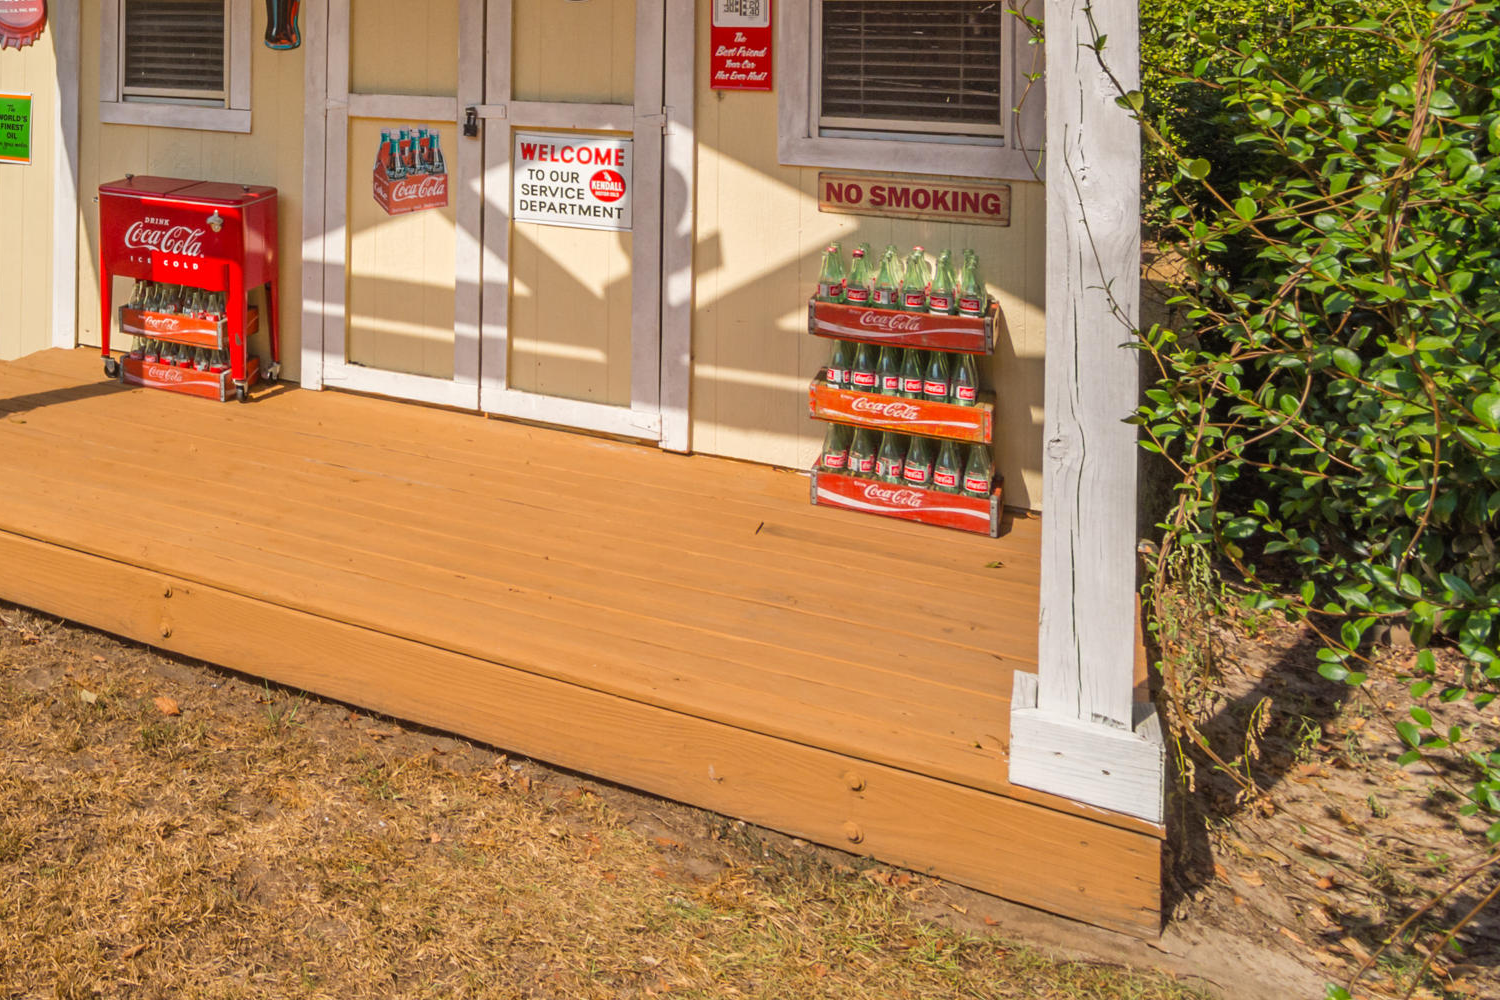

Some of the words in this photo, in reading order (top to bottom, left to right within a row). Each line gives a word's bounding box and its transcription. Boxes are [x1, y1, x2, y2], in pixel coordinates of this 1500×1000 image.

[714, 45, 737, 56] Best
[736, 46, 767, 57] Friend
[0, 122, 24, 131] FINEST
[6, 131, 18, 139] OIL
[520, 142, 625, 167] WELCOME
[527, 168, 545, 181] TO
[549, 170, 580, 184] OUR
[392, 176, 445, 202] Coca-Cola
[521, 183, 585, 200] SERVICE
[590, 180, 623, 192] KENDALL
[825, 182, 863, 204] NO
[868, 185, 1002, 216] SMOKING
[519, 199, 624, 219] DEPARTMENT
[144, 216, 170, 226] DRINK
[124, 221, 206, 257] Coca-Cola
[163, 259, 199, 270] COLD
[860, 311, 923, 331] Coca-Cola
[851, 397, 920, 420] Coca-Cola
[864, 483, 925, 507] Coca-Cola
